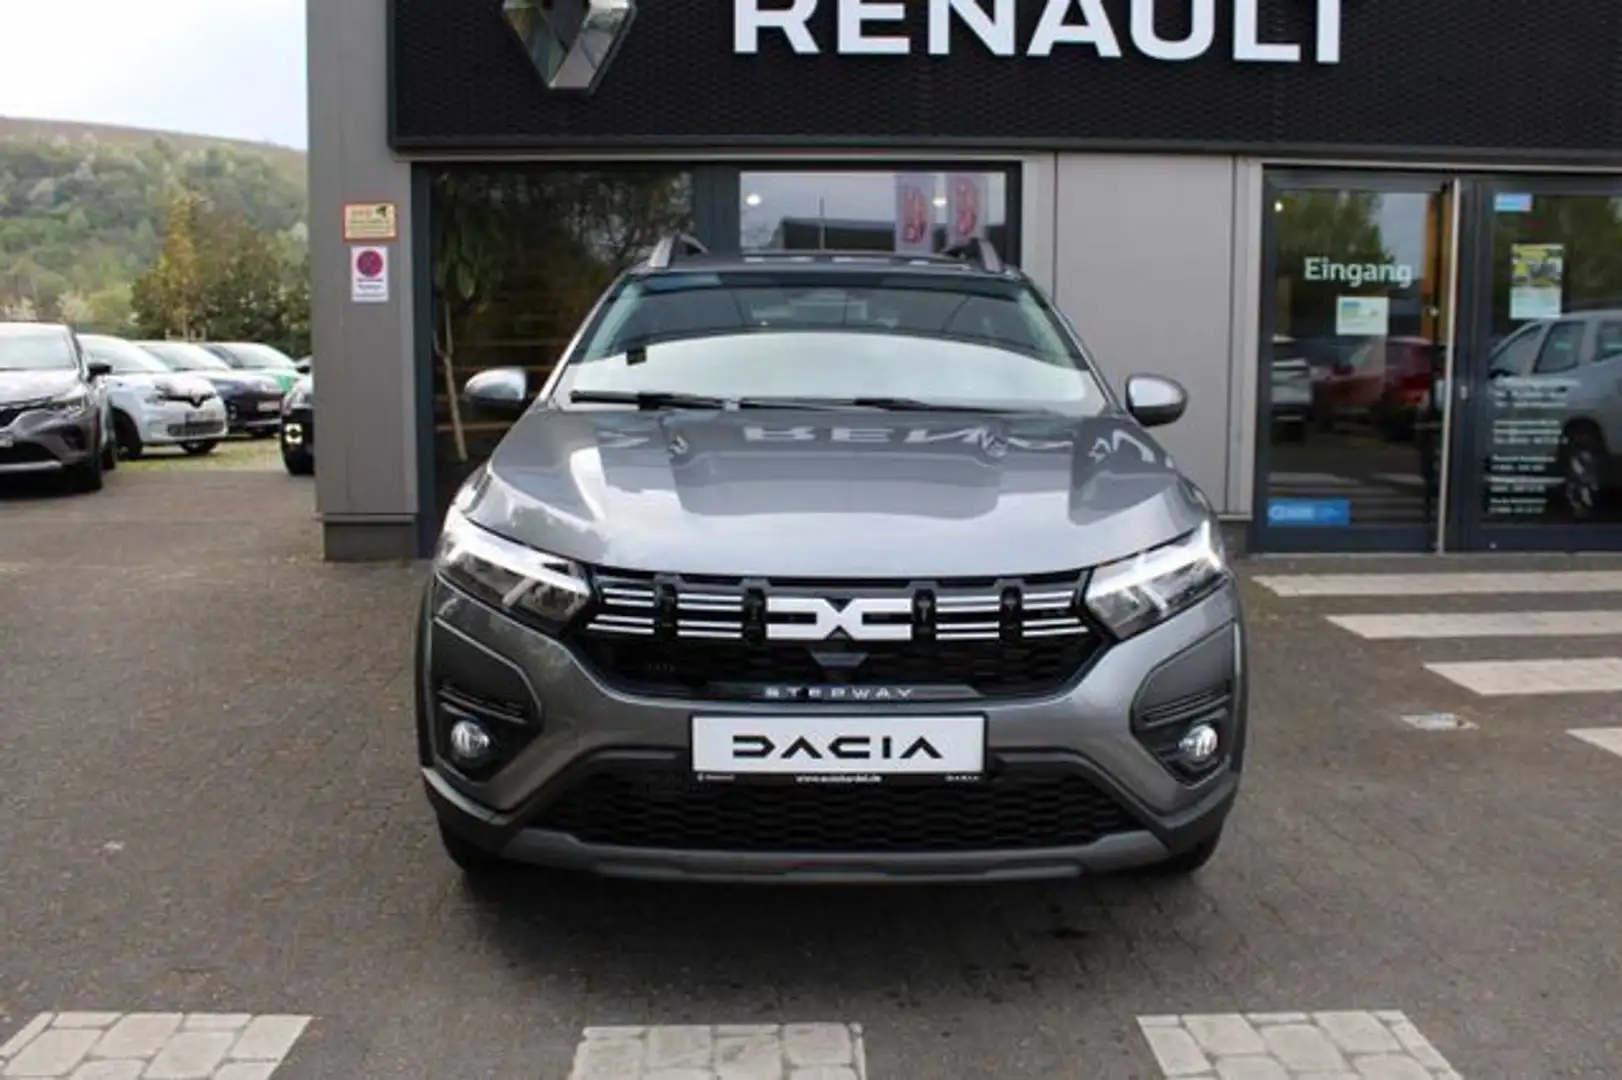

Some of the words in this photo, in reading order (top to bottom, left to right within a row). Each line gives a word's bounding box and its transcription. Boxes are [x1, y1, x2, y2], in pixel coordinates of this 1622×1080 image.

[1303, 255, 1413, 288] Eingang
[765, 685, 912, 700] STEPWAY
[733, 734, 944, 760] DACIA
